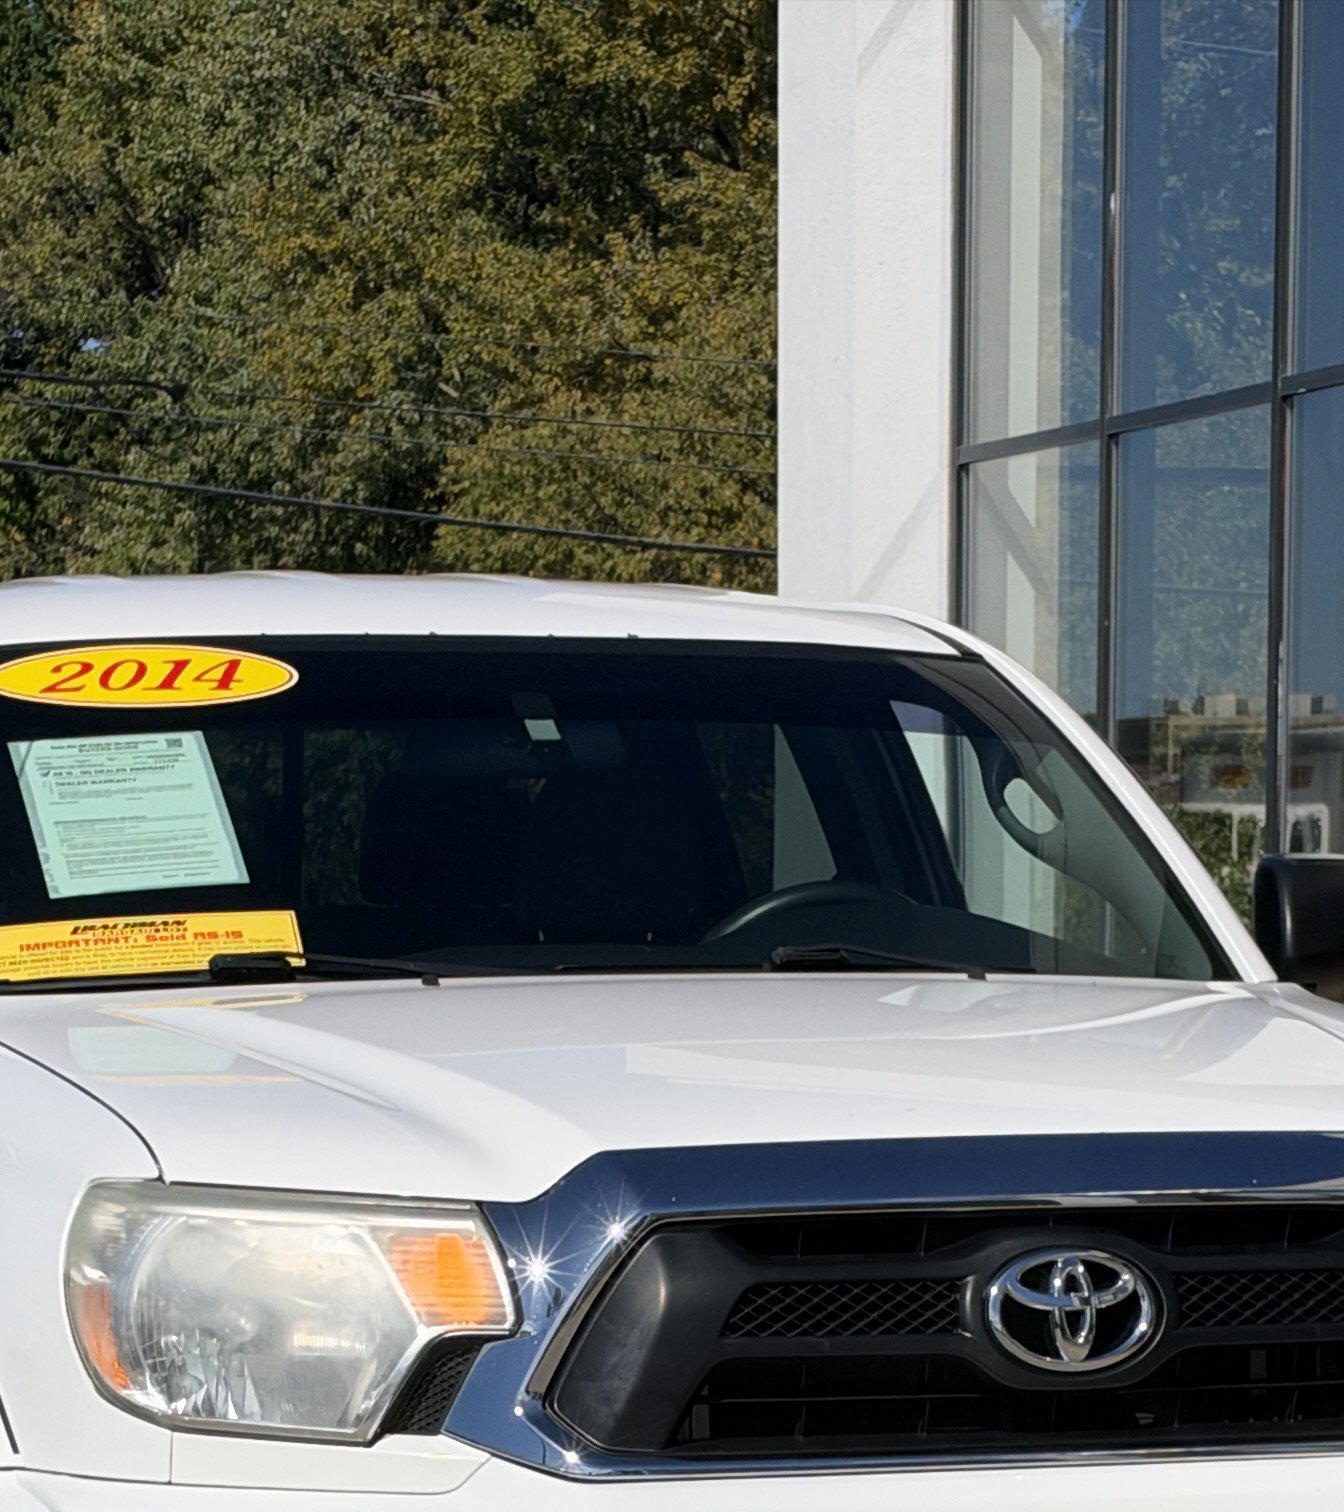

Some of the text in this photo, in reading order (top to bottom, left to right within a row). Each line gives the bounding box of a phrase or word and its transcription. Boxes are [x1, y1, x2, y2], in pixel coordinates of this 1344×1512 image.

[40, 657, 243, 694] 2014
[19, 930, 244, 952] IMPORTANT: Sold AS-IS
